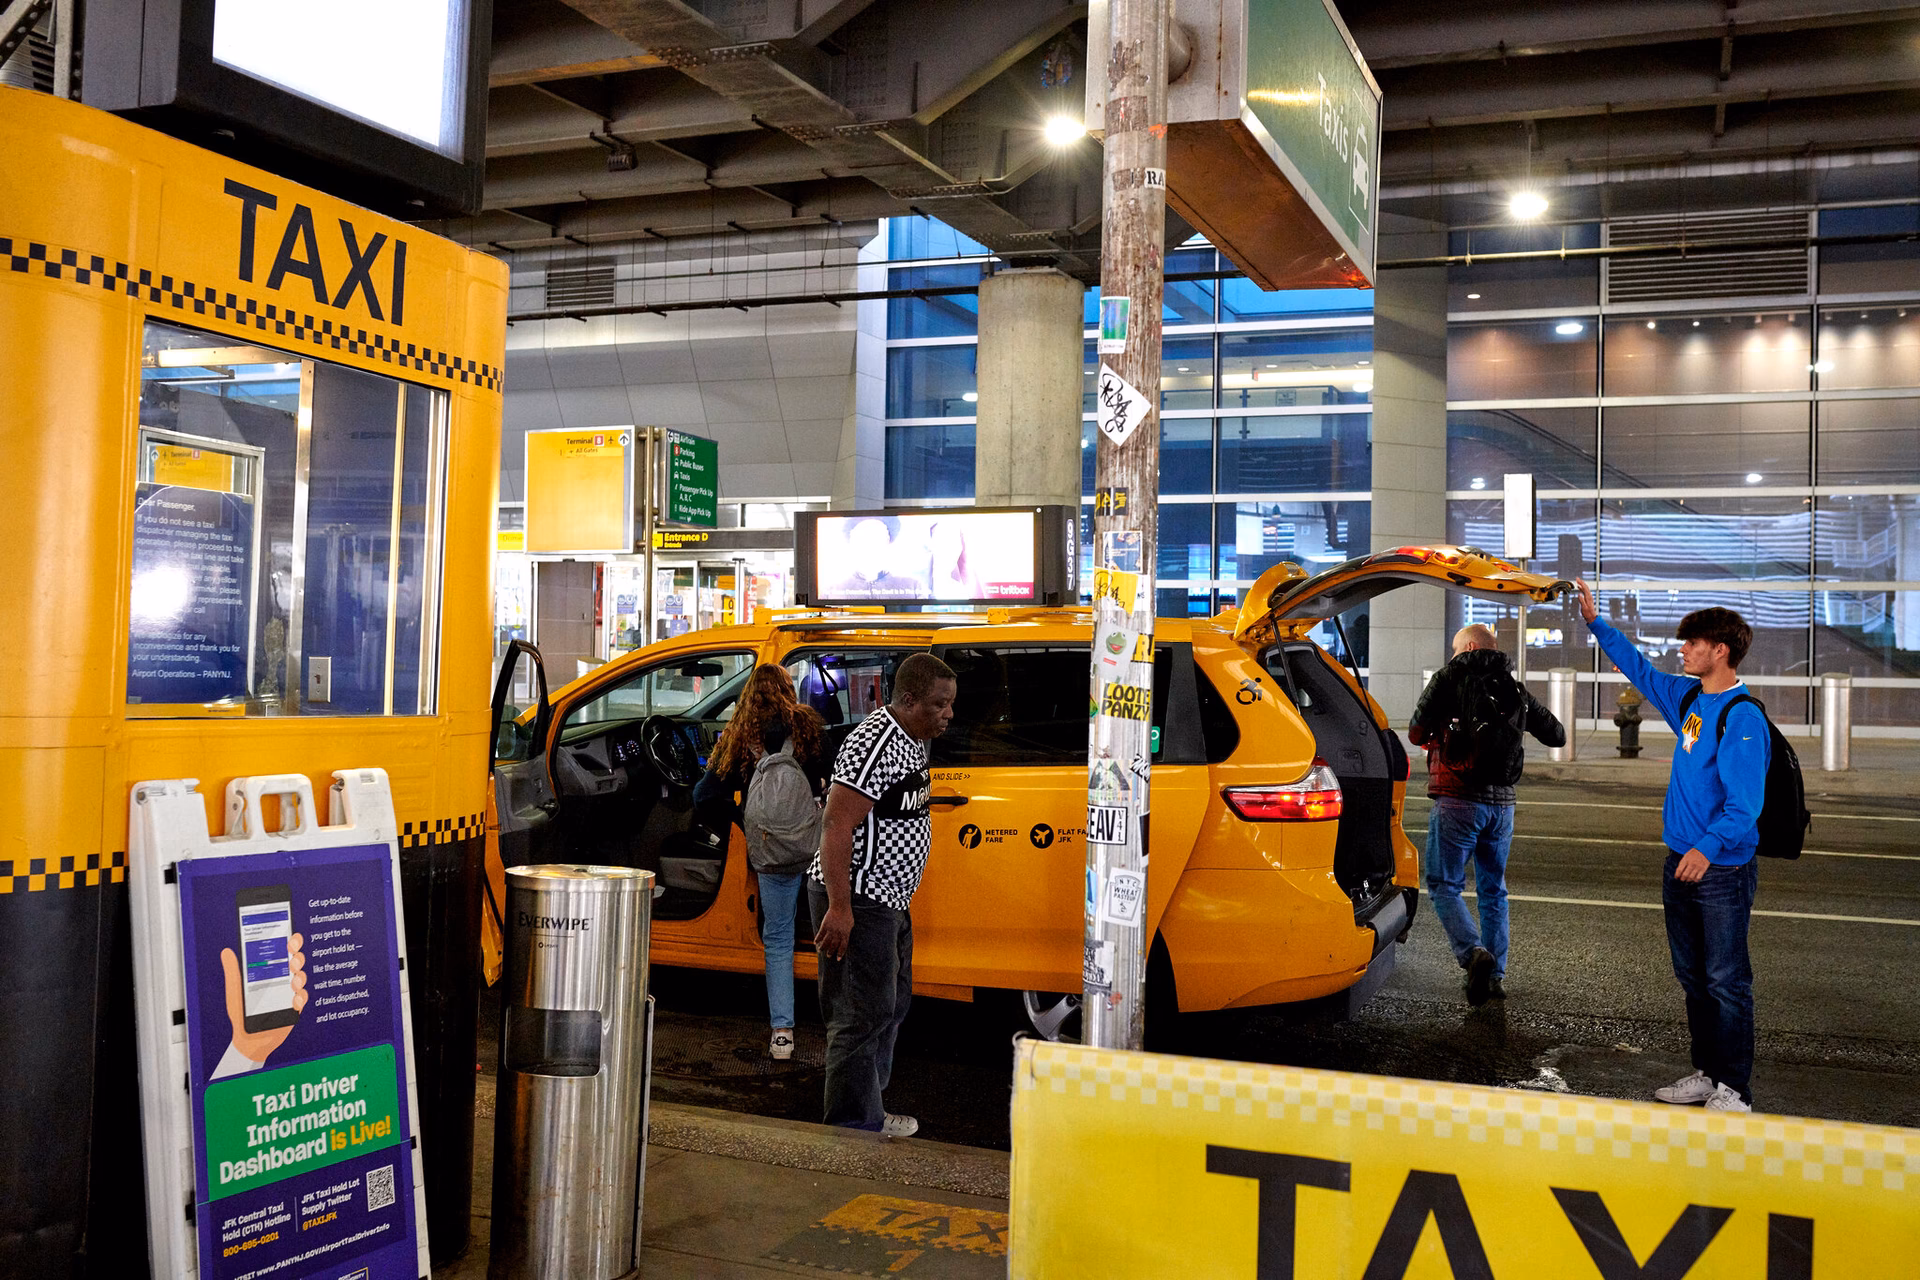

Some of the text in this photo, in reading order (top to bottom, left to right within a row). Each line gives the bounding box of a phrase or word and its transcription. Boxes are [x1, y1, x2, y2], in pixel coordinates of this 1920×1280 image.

[1318, 71, 1349, 164] Taxis
[224, 178, 407, 326] TAXI
[566, 437, 594, 445] Terminal
[680, 435, 696, 446] AirTrain
[680, 447, 696, 460] Parking
[680, 459, 704, 471] Public Buses
[680, 471, 691, 481] Taxis
[679, 483, 714, 498] Passenger Pick Up
[679, 504, 712, 518] Ride App Pick Up
[143, 516, 157, 524] you
[136, 526, 174, 535] dispatcher
[175, 530, 209, 540] managing
[210, 532, 220, 540] the
[664, 532, 709, 542] Entrance D
[173, 540, 197, 549] please
[198, 543, 224, 552] proceed
[190, 552, 203, 560] taxi
[204, 553, 216, 561] line
[217, 554, 230, 562] and
[231, 555, 244, 563] take
[1066, 521, 1075, 591] 9G37
[220, 587, 240, 595] please
[1000, 584, 1030, 594] britbox
[183, 632, 193, 640] for
[194, 634, 206, 642] any
[133, 643, 184, 651] inconvenience
[199, 644, 218, 652] thank
[219, 645, 231, 653] you
[132, 654, 149, 662] your
[132, 669, 156, 679] Airport
[157, 669, 196, 678] Operations
[1101, 700, 1150, 721] PANZY
[932, 772, 963, 780] AND SLIDE
[1119, 879, 1137, 888] NYC
[1114, 887, 1138, 897] WHEAT
[308, 895, 352, 908] Get up-to-date
[310, 909, 363, 924] information before
[518, 911, 590, 931] EVERWIPE
[310, 927, 352, 943] you get to the
[312, 943, 355, 958] airport hold lot
[312, 960, 358, 974] like the average
[313, 974, 367, 990] wait time, number
[315, 988, 370, 1007] of taxis dispatched,
[316, 1006, 370, 1024] and lot occupancy.
[252, 1073, 359, 1117] Taxi Driver
[246, 1099, 367, 1148] Information
[219, 1115, 391, 1185] Dashboard is Live!
[301, 1177, 360, 1205] JFK Taxi Hold Lot
[301, 1193, 353, 1216] Supply Twitter
[222, 1201, 284, 1230] JFK Central Taxi
[302, 1211, 338, 1231] @TAXIJFK
[222, 1213, 292, 1243] Hold (CTH) Hotline
